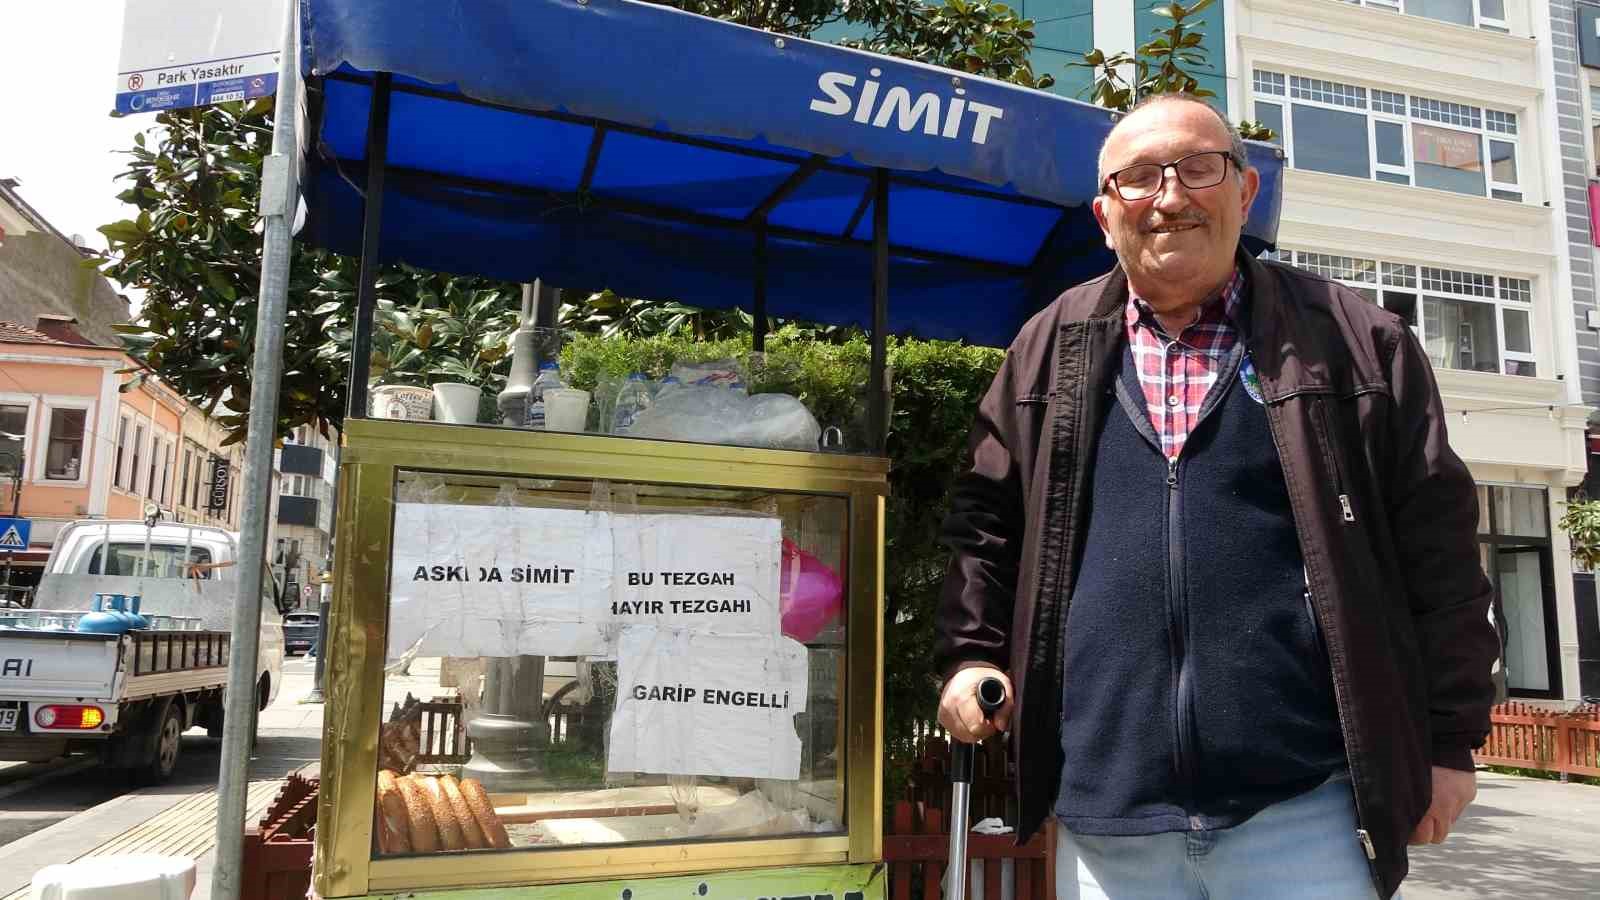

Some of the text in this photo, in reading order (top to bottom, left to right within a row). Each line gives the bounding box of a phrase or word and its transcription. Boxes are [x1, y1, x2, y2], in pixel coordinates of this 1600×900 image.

[158, 64, 245, 85] Park Yasaktır
[810, 67, 1004, 145] SİMİT
[510, 564, 575, 584] SİMİT
[628, 572, 735, 586] BU TEZGAH
[669, 599, 751, 614] TEZGAHI
[632, 683, 789, 709] GARİP ENGELLİ
